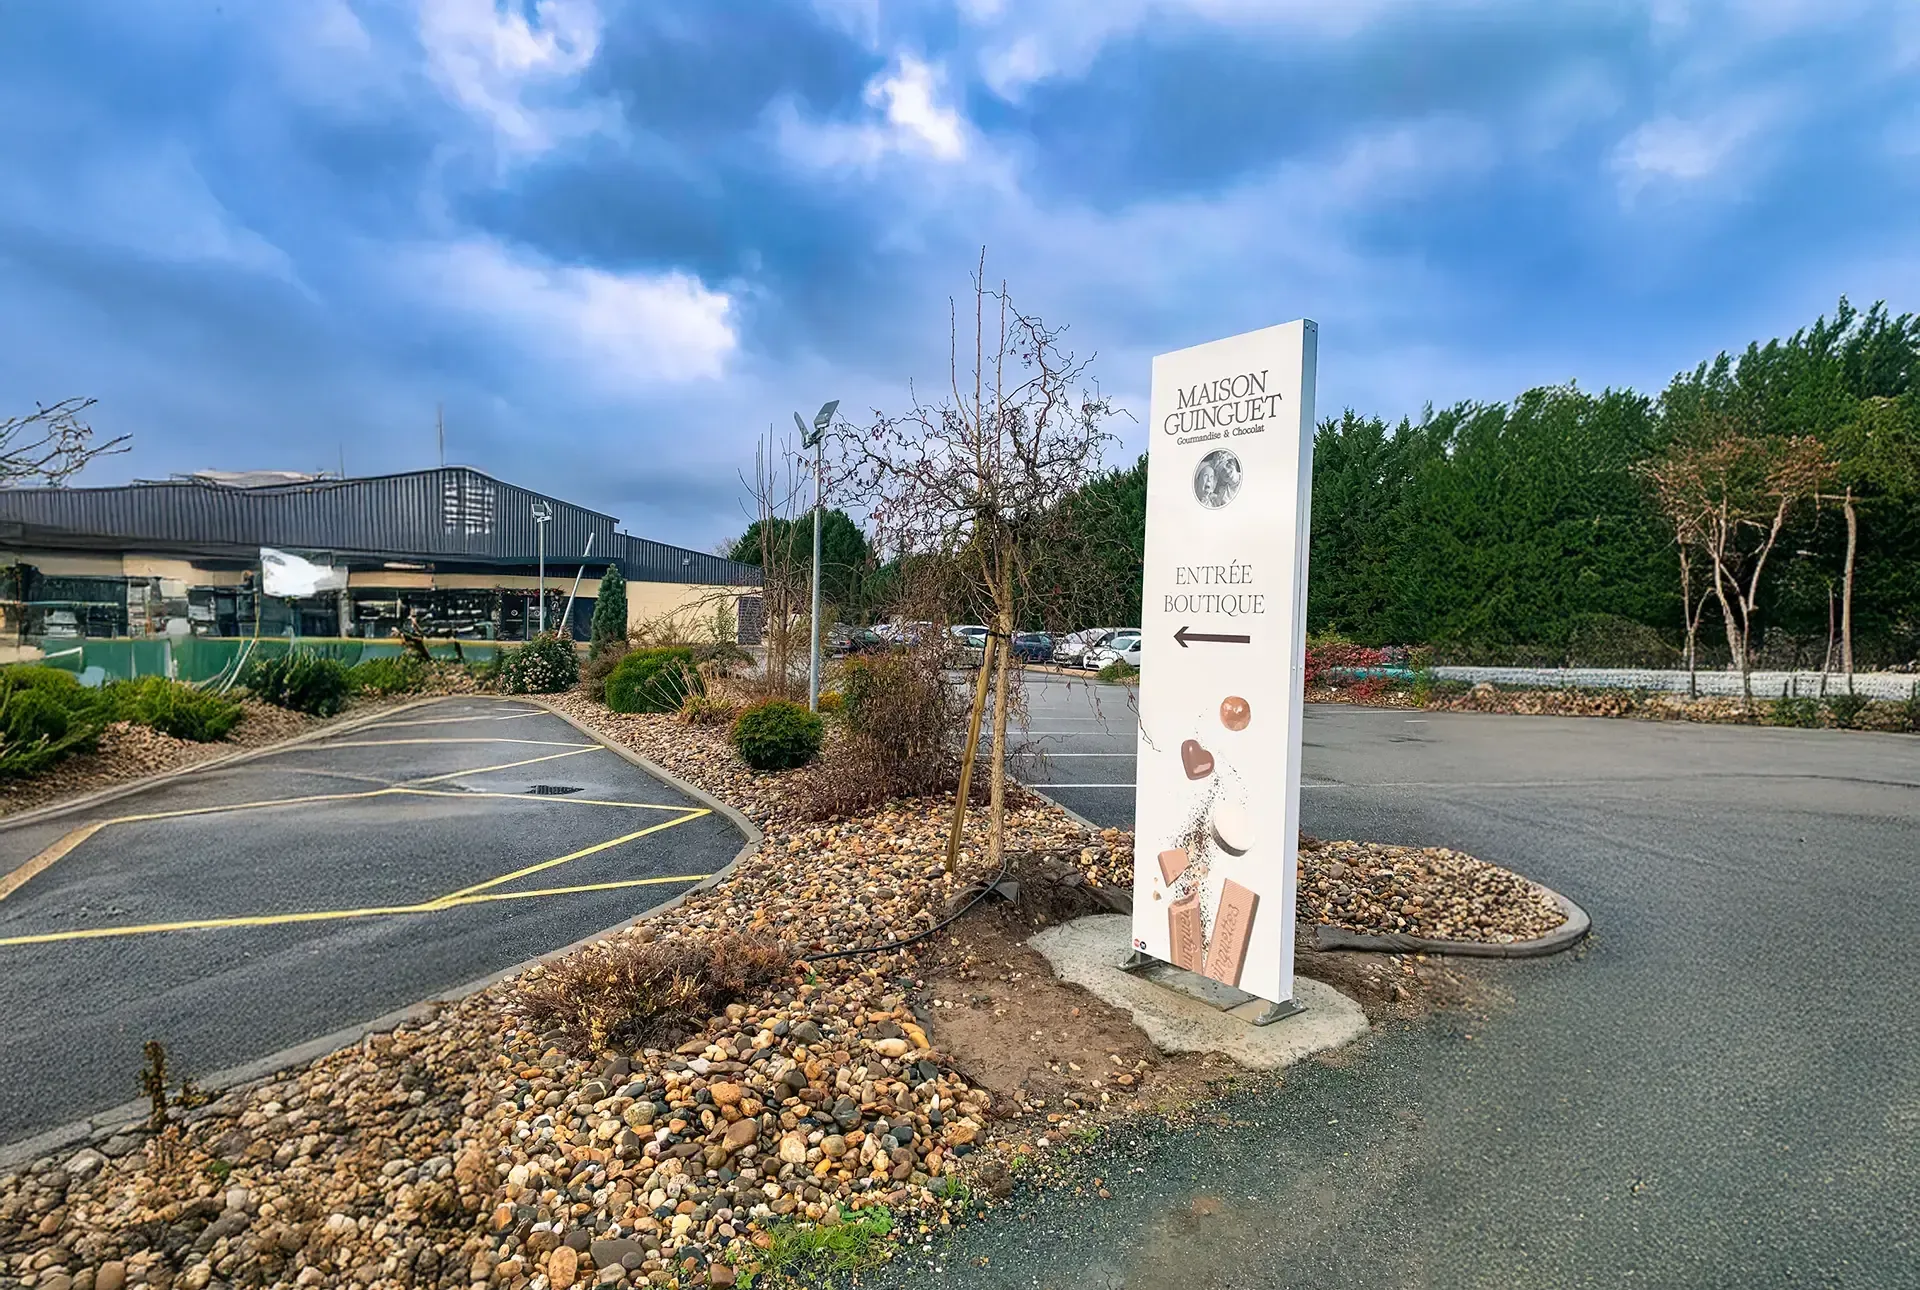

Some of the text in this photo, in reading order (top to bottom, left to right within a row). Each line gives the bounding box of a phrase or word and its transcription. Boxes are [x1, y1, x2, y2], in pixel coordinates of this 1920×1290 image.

[1177, 370, 1268, 410] MAISON
[1164, 393, 1282, 436] GUINGUET
[1177, 424, 1265, 445] Gourmandise & Chocolat
[1176, 559, 1253, 585] ENTRÉE
[1164, 594, 1265, 617] BOUTIQUE
